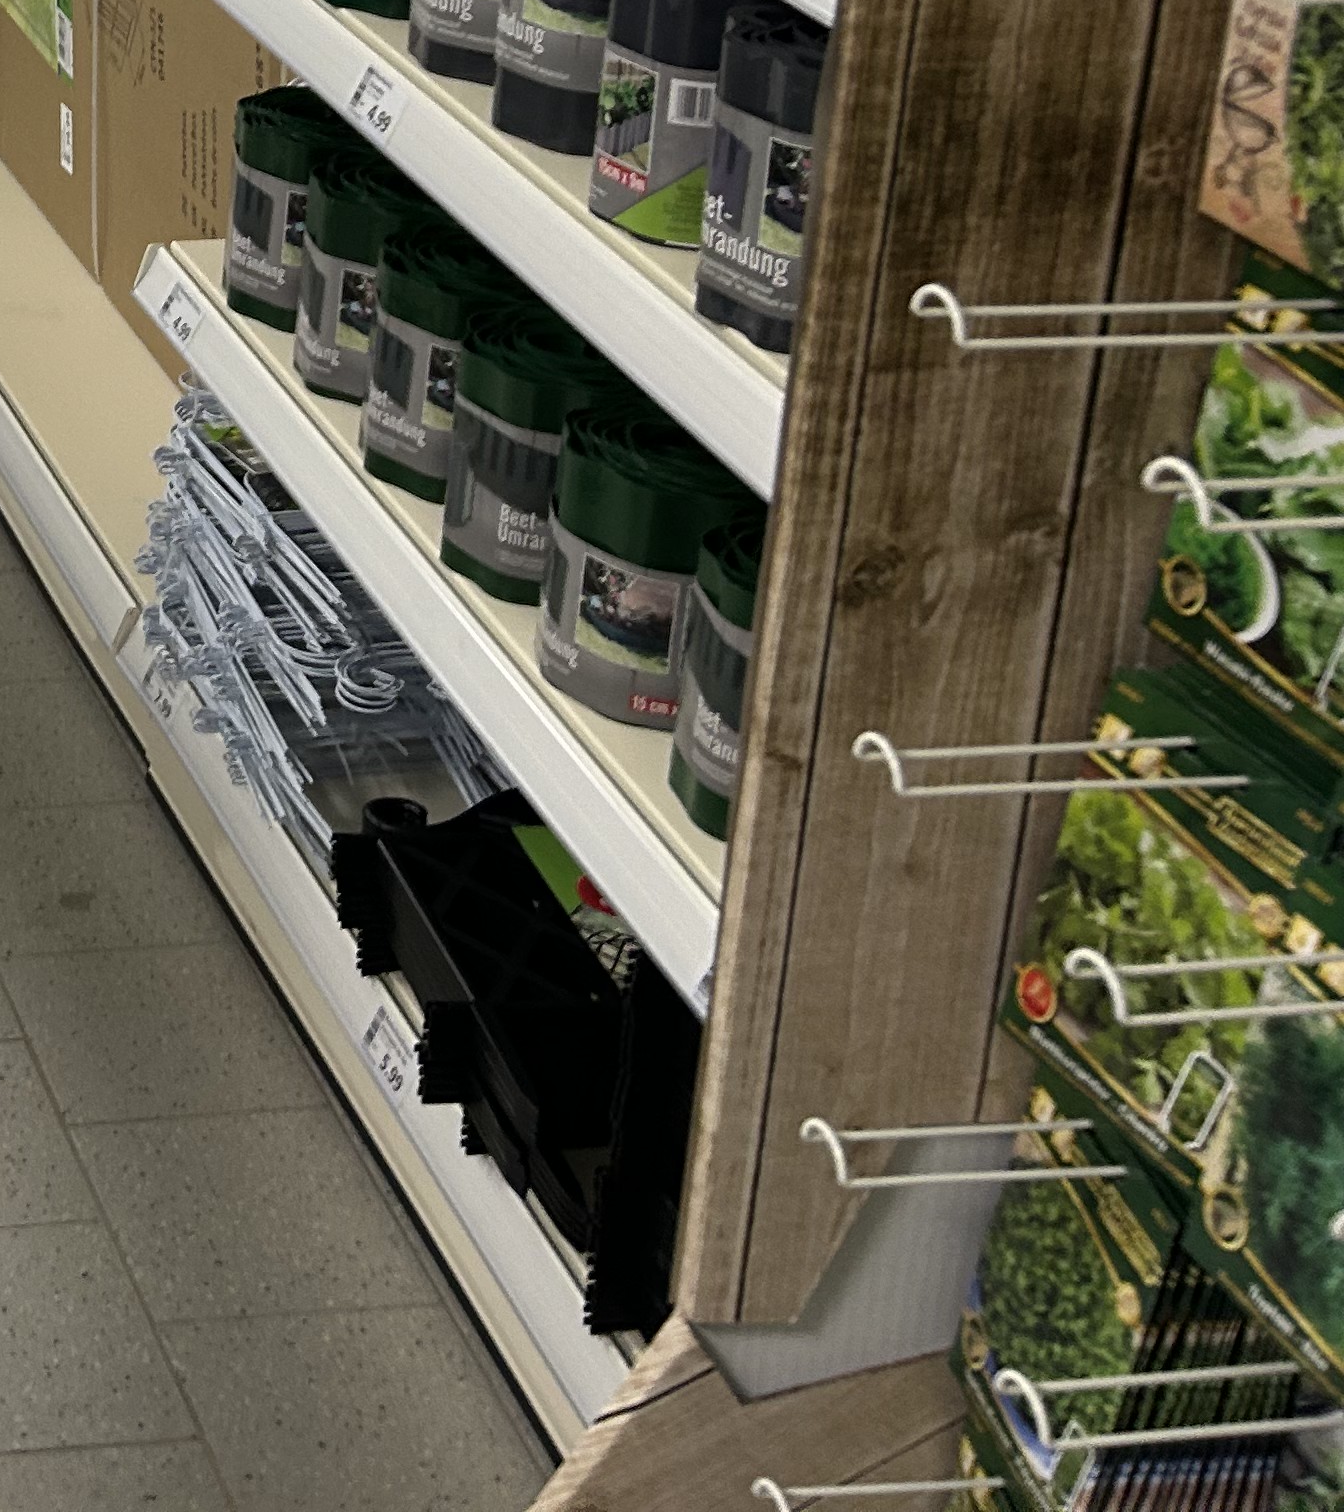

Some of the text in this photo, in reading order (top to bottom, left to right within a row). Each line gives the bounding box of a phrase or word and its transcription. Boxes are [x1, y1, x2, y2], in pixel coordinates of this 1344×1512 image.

[367, 105, 392, 133] 4.99
[499, 503, 546, 531] Beet-
[378, 1052, 403, 1093] 5.99
